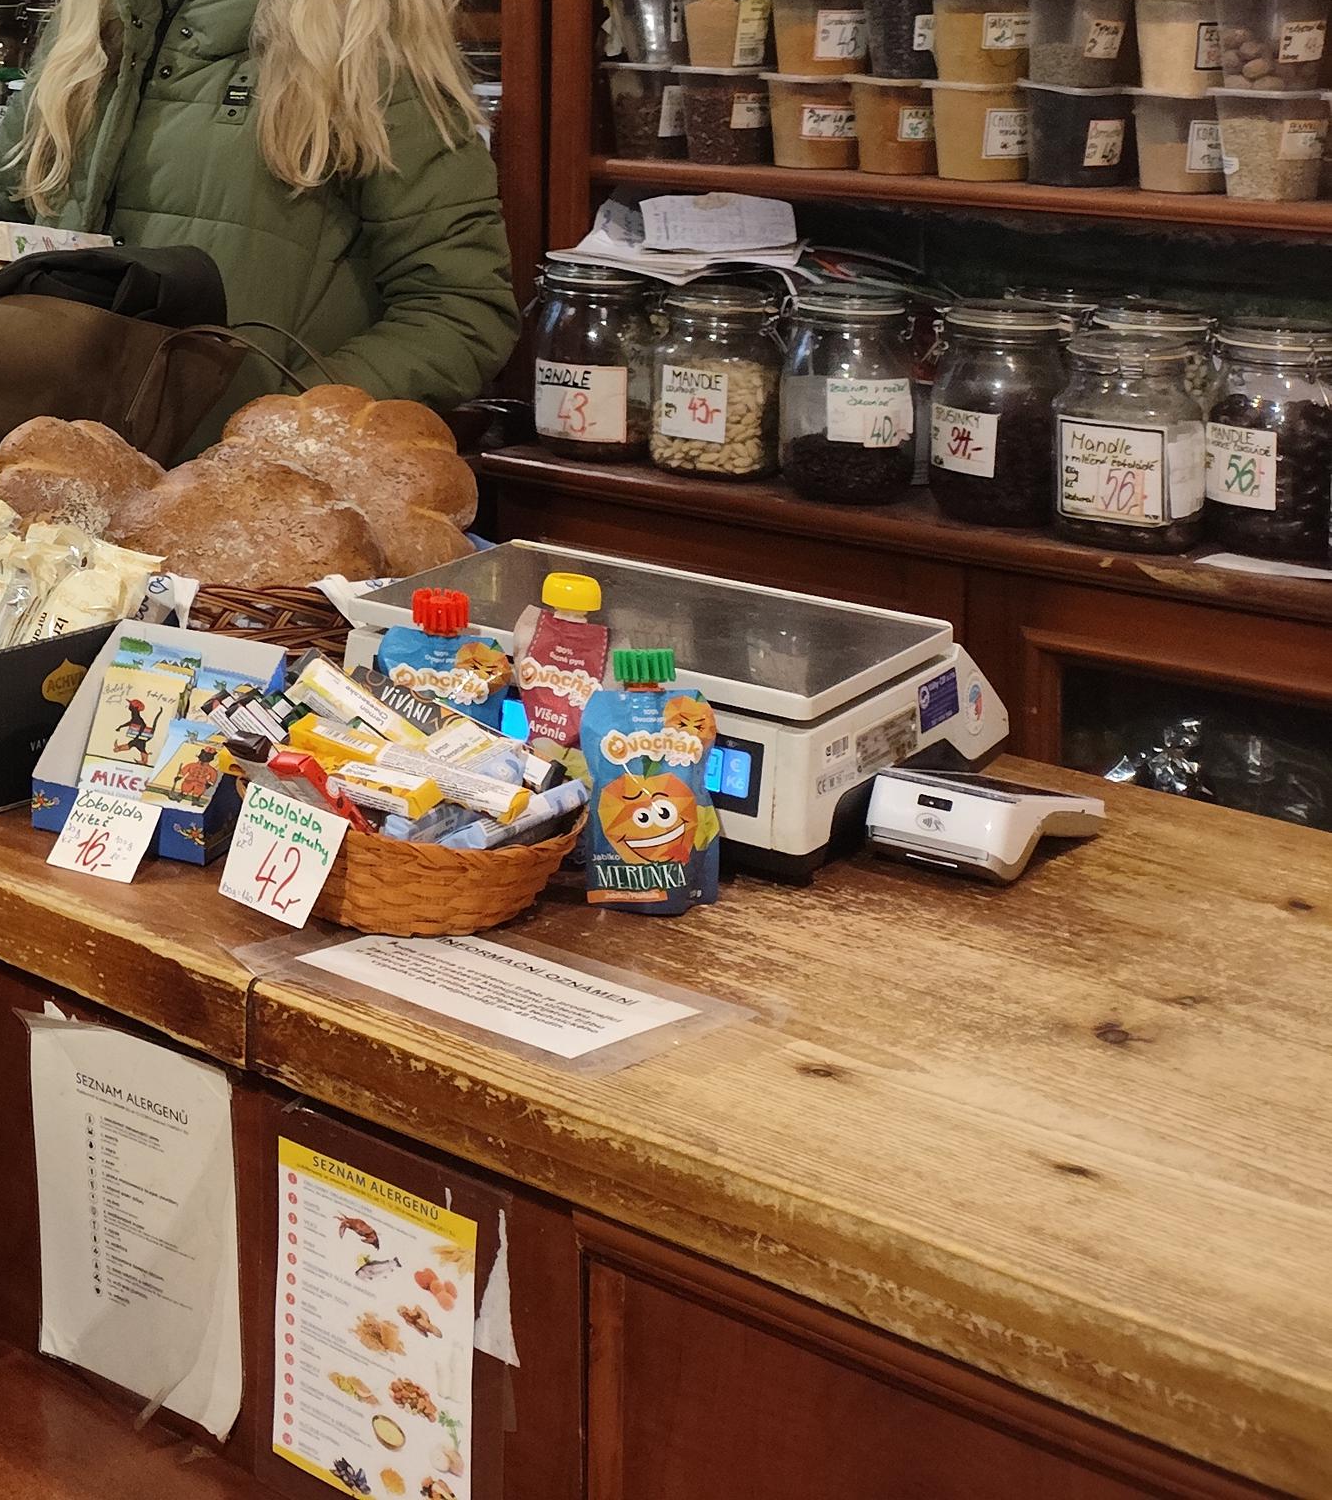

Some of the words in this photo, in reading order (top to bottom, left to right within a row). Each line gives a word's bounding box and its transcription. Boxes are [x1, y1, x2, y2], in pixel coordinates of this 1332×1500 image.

[538, 367, 591, 386] MANDLE
[672, 369, 722, 392] MANDLE
[1070, 431, 1133, 458] Mandle
[534, 705, 569, 727] Višeň
[605, 729, 703, 762] Ovocňák
[77, 790, 143, 821] Čokoláda
[248, 786, 322, 833] Čokoláda
[292, 829, 329, 866] druhy
[591, 853, 621, 863] Jablko
[595, 861, 688, 892] MERUŇKA
[75, 1072, 124, 1100] SEZNAM
[125, 1091, 189, 1126] ALERGENŮ
[312, 1155, 367, 1189] SEZNAM
[370, 1183, 440, 1222] ALERGENŮ
